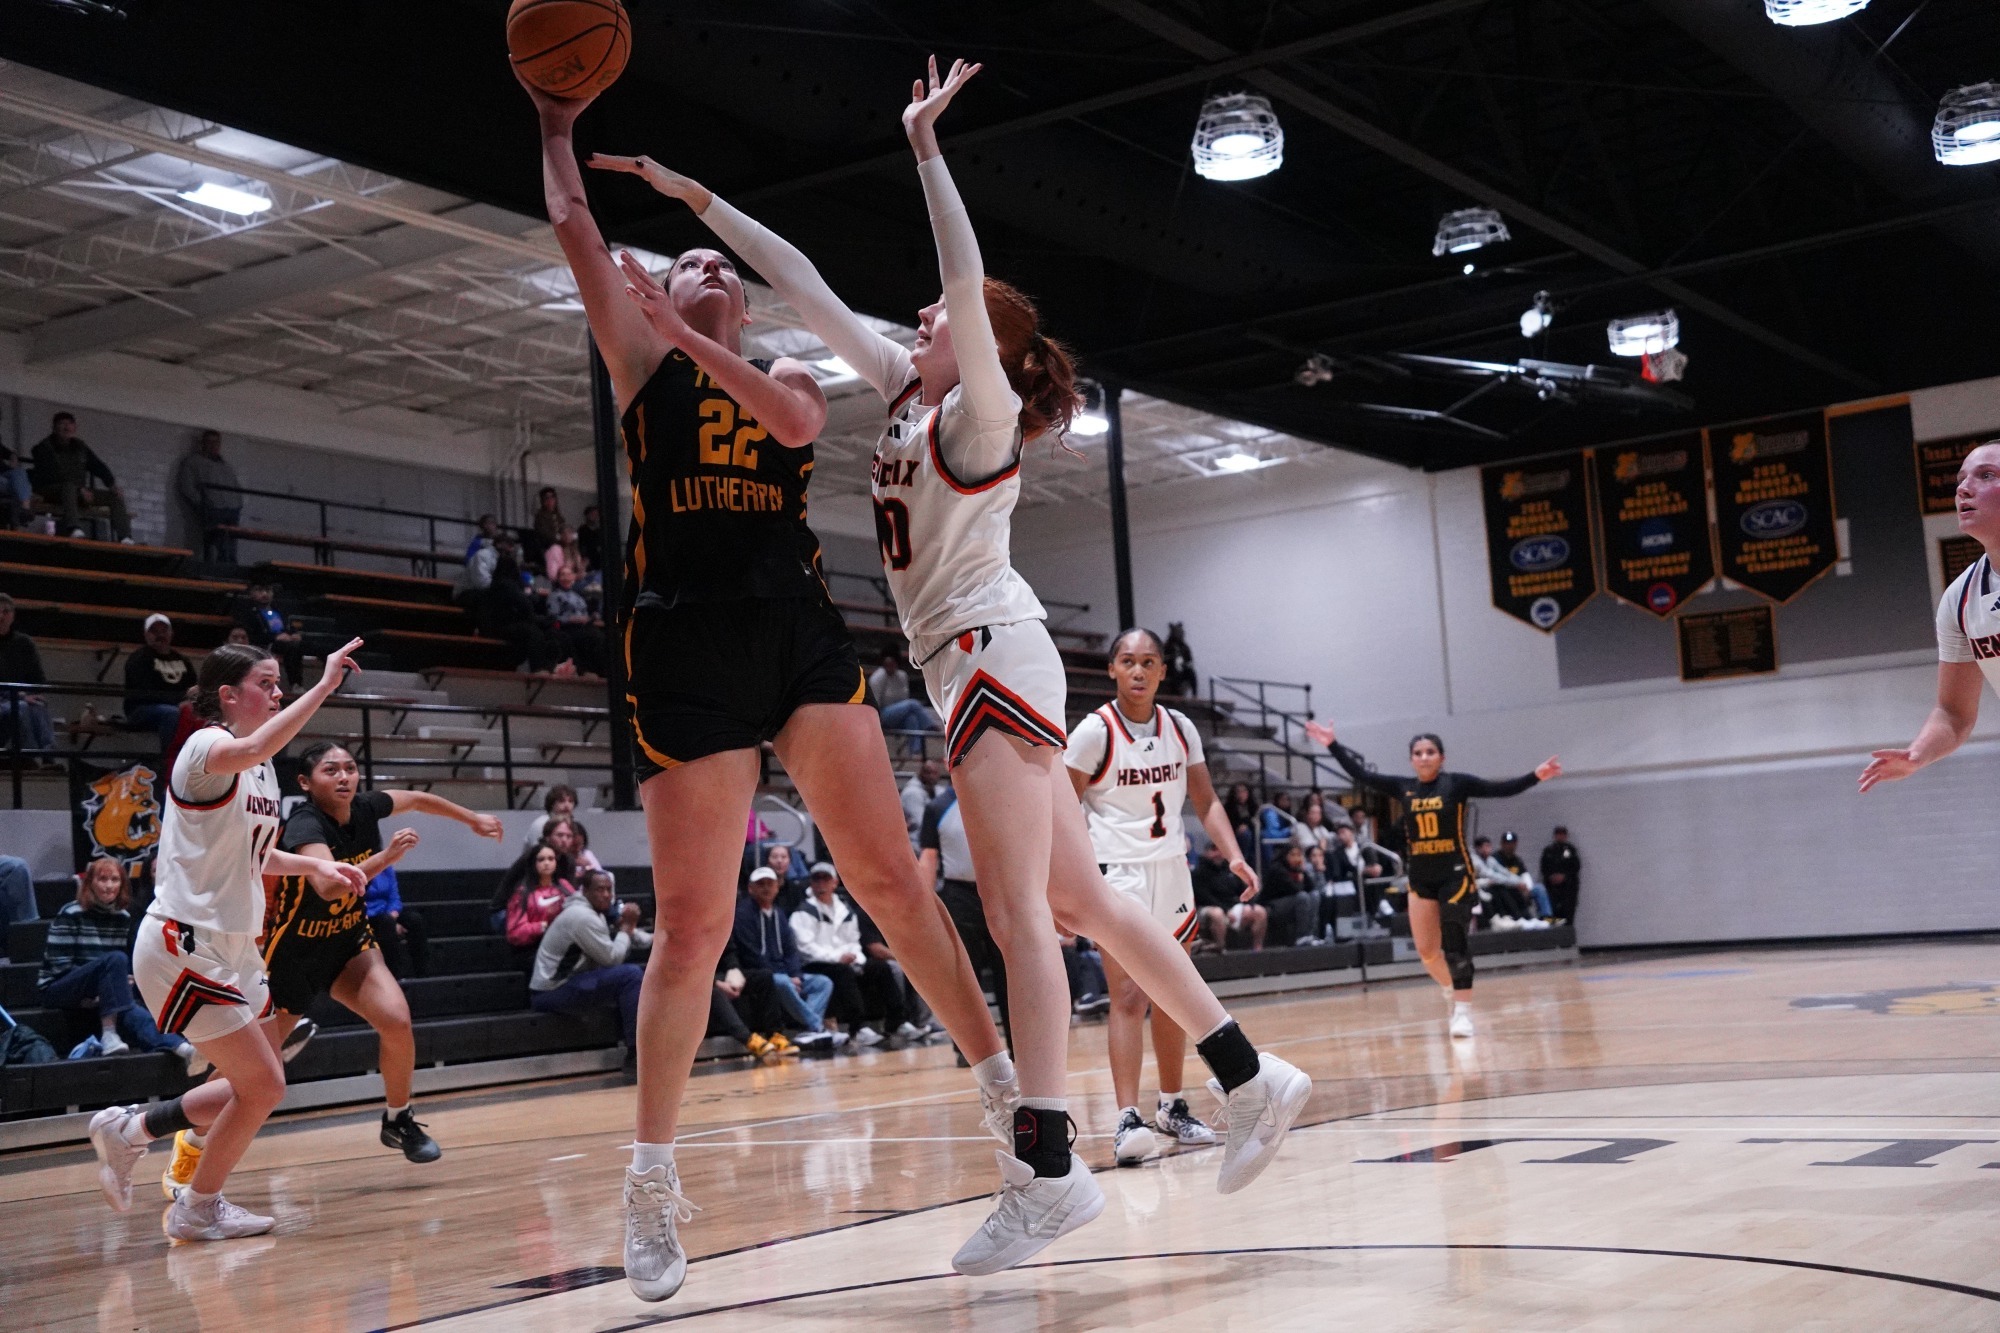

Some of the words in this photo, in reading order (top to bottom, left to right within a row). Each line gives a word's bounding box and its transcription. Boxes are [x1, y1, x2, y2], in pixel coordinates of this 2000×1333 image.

[699, 398, 768, 470] 22
[1748, 506, 1801, 530] SCAC
[1150, 791, 1167, 838] 1
[1411, 796, 1443, 812] TEXAS
[1416, 811, 1440, 838] 10
[250, 824, 275, 880] 14
